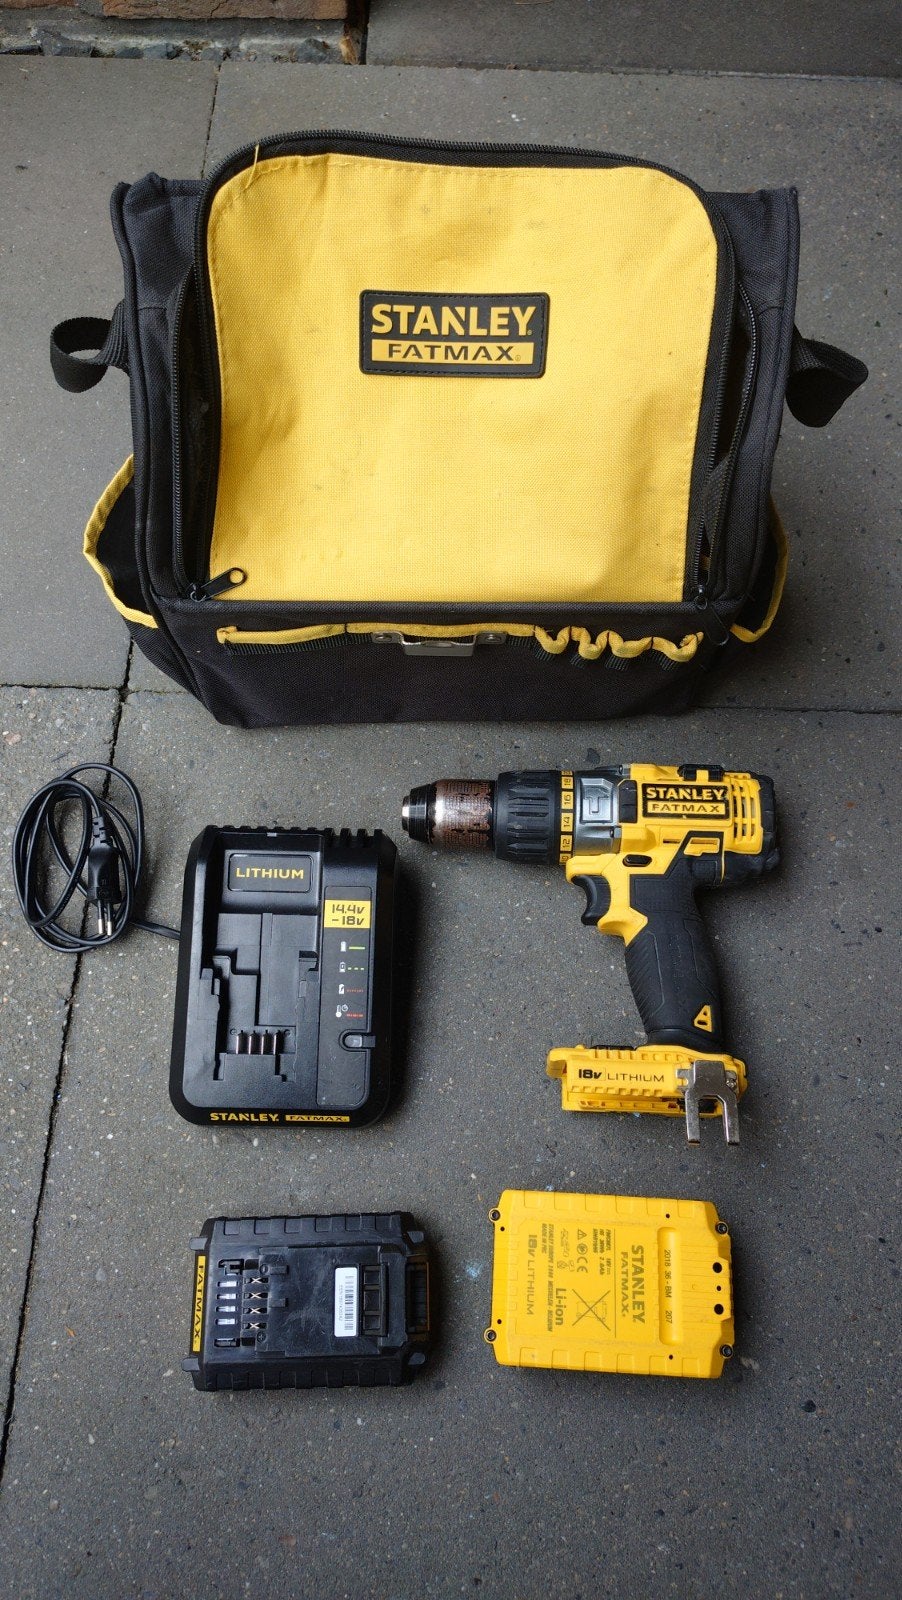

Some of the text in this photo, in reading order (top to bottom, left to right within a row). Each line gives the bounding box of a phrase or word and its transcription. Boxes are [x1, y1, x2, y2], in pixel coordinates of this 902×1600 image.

[371, 303, 537, 336] STANLEY
[387, 343, 514, 362] FATMAX
[563, 794, 571, 805] 16
[645, 787, 724, 800] STANLEY
[652, 803, 720, 812] FATMAX
[563, 816, 570, 827] 14
[562, 838, 570, 848] 12
[236, 867, 304, 879] LITHIUM
[607, 1072, 665, 1082] LITHIUM
[209, 1112, 279, 1122] STANLEY
[663, 1249, 672, 1267] 2018
[526, 1259, 536, 1315] LITHIUM
[620, 1251, 630, 1313] FATMAX
[631, 1244, 646, 1324] STANLEY
[194, 1264, 204, 1338] FATMAX
[555, 1288, 567, 1326] Li-ion
[665, 1310, 673, 1324] 207
